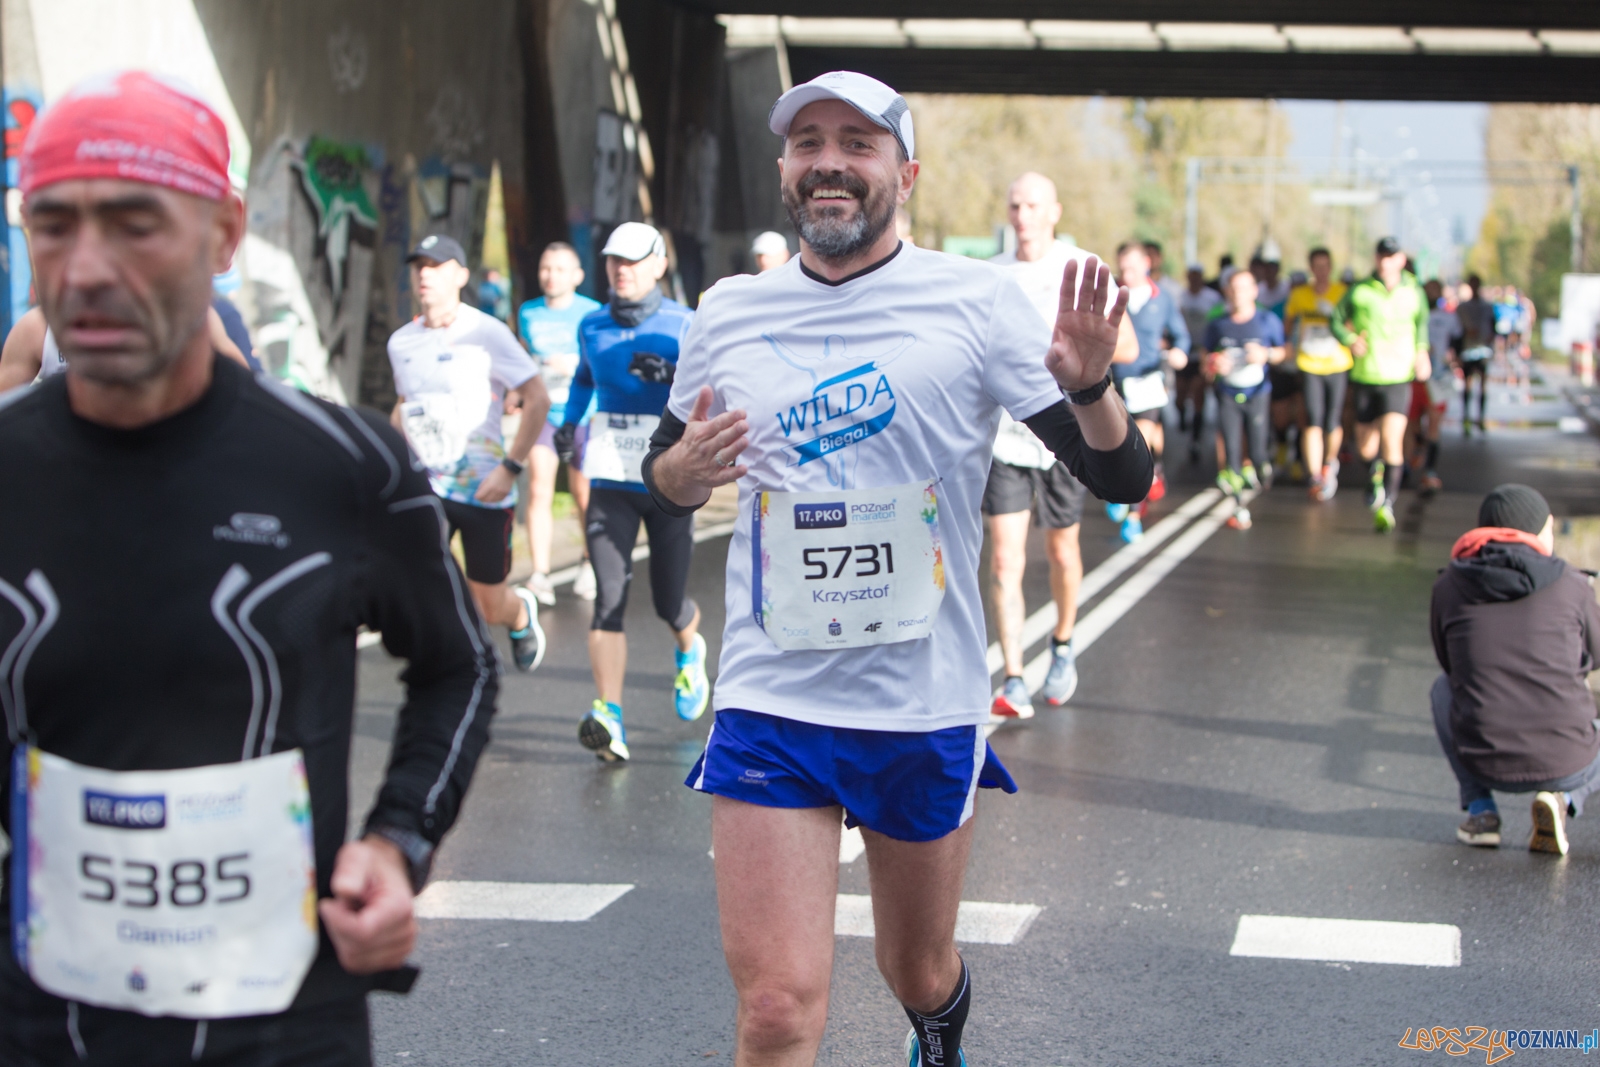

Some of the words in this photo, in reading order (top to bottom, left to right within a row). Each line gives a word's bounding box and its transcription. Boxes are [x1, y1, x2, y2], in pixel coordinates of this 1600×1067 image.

[776, 374, 895, 438] WILDA
[819, 421, 869, 454] Biega!
[851, 511, 896, 522] maraton
[803, 542, 894, 580] 5731
[812, 584, 890, 604] Krzysztof
[80, 852, 250, 909] 5385
[916, 1015, 949, 1067] Kalenji
